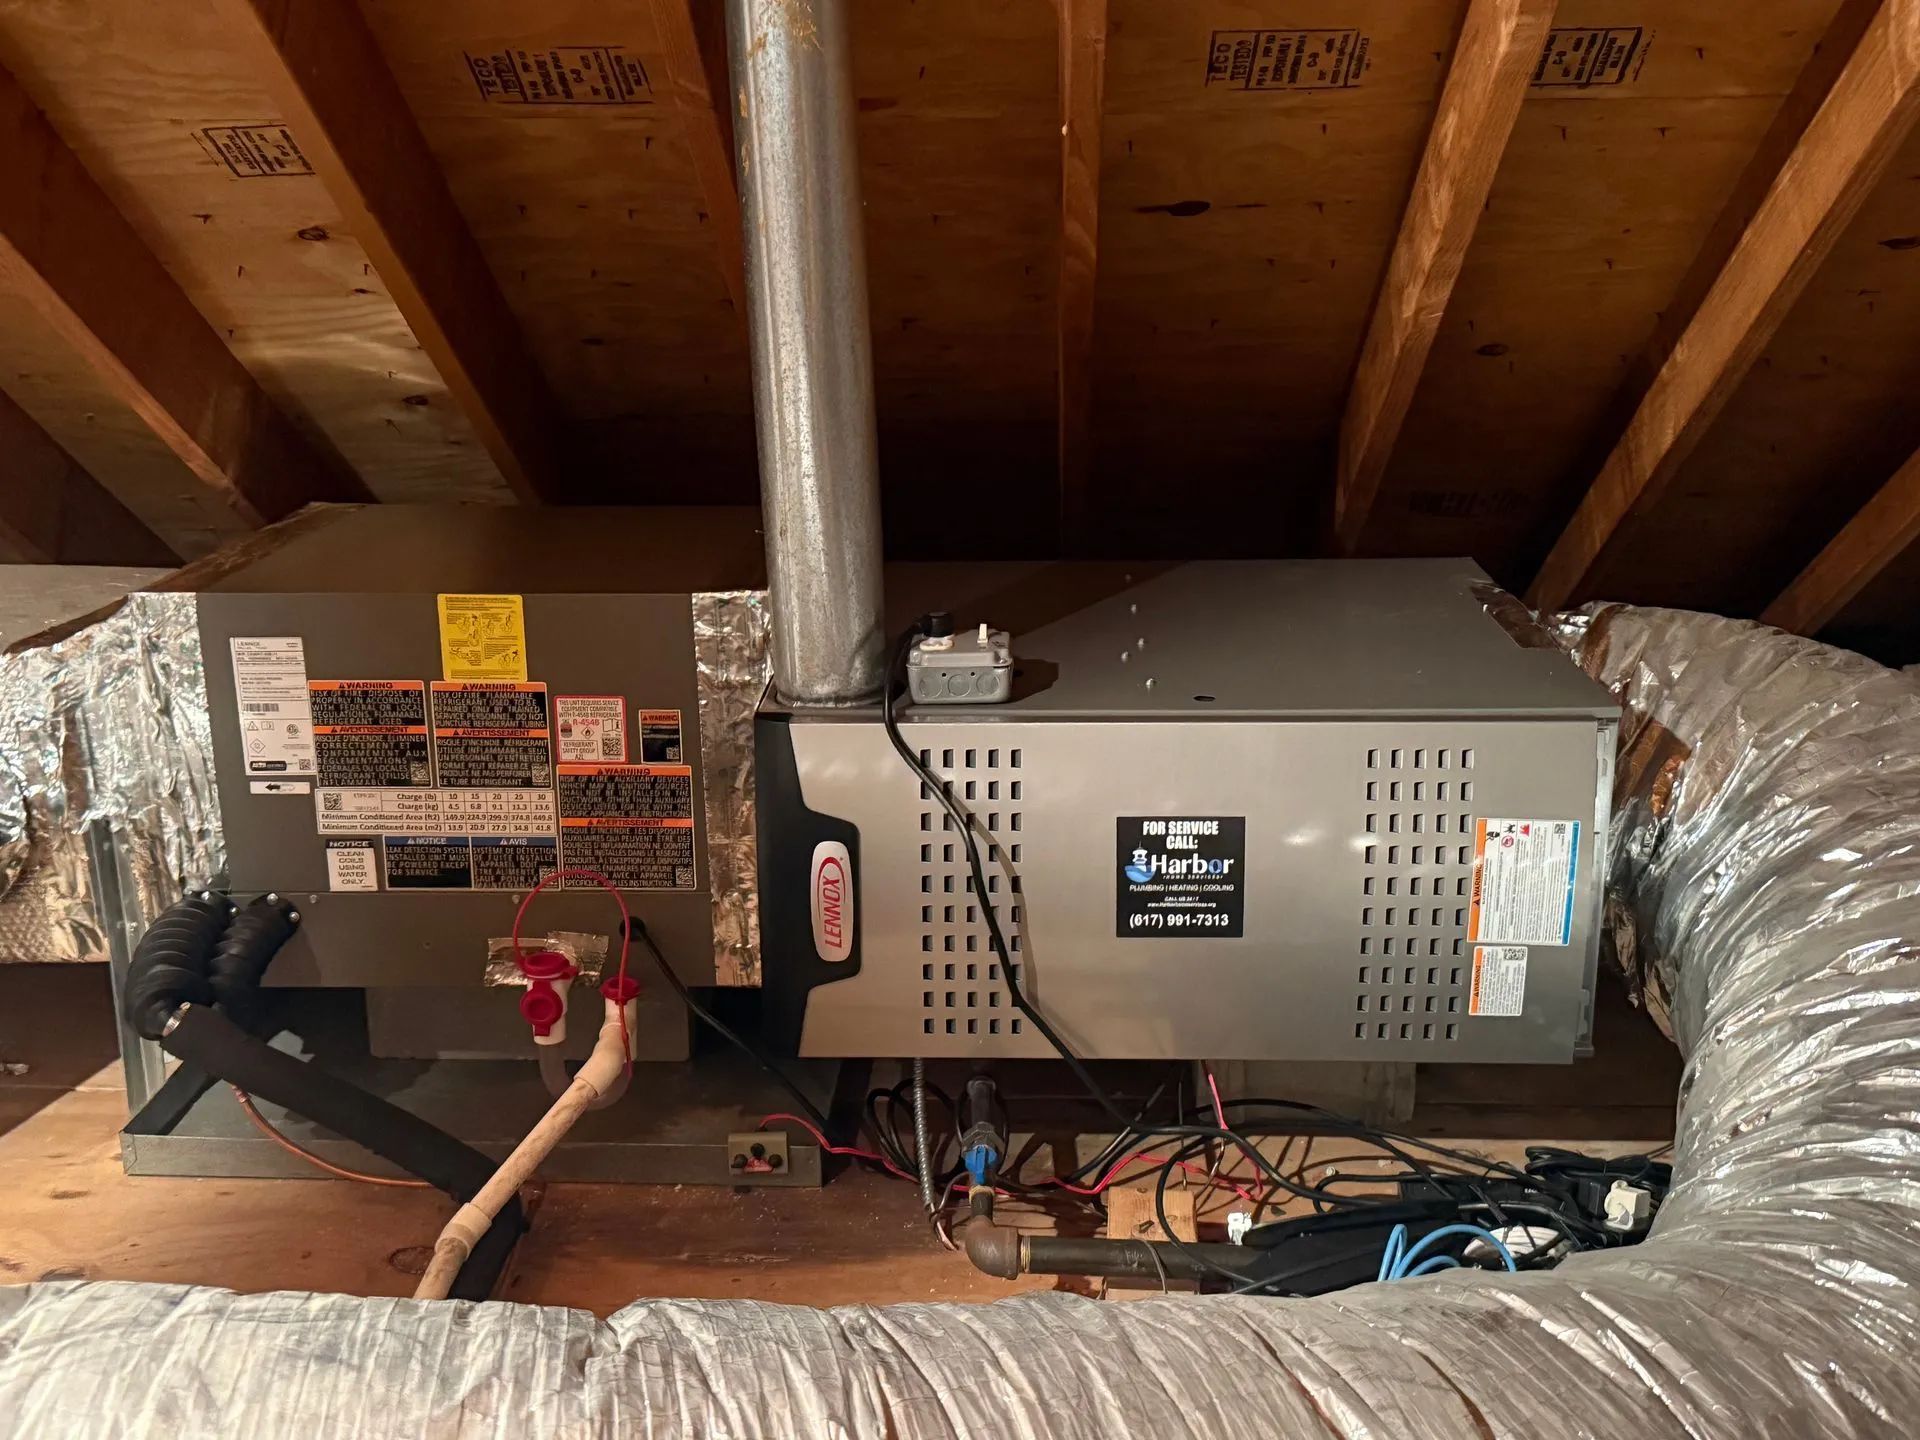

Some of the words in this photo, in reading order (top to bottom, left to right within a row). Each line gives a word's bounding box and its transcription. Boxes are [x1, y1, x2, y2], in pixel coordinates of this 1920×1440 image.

[474, 58, 499, 96] TECO
[1143, 821, 1166, 835] FOR
[1168, 821, 1219, 835] SERVICE
[1166, 836, 1198, 849] CALL:
[1151, 853, 1234, 874] Harbor
[823, 875, 842, 948] LENNOX
[1130, 914, 1163, 928] (617)
[1167, 914, 1229, 926] 991-7313
